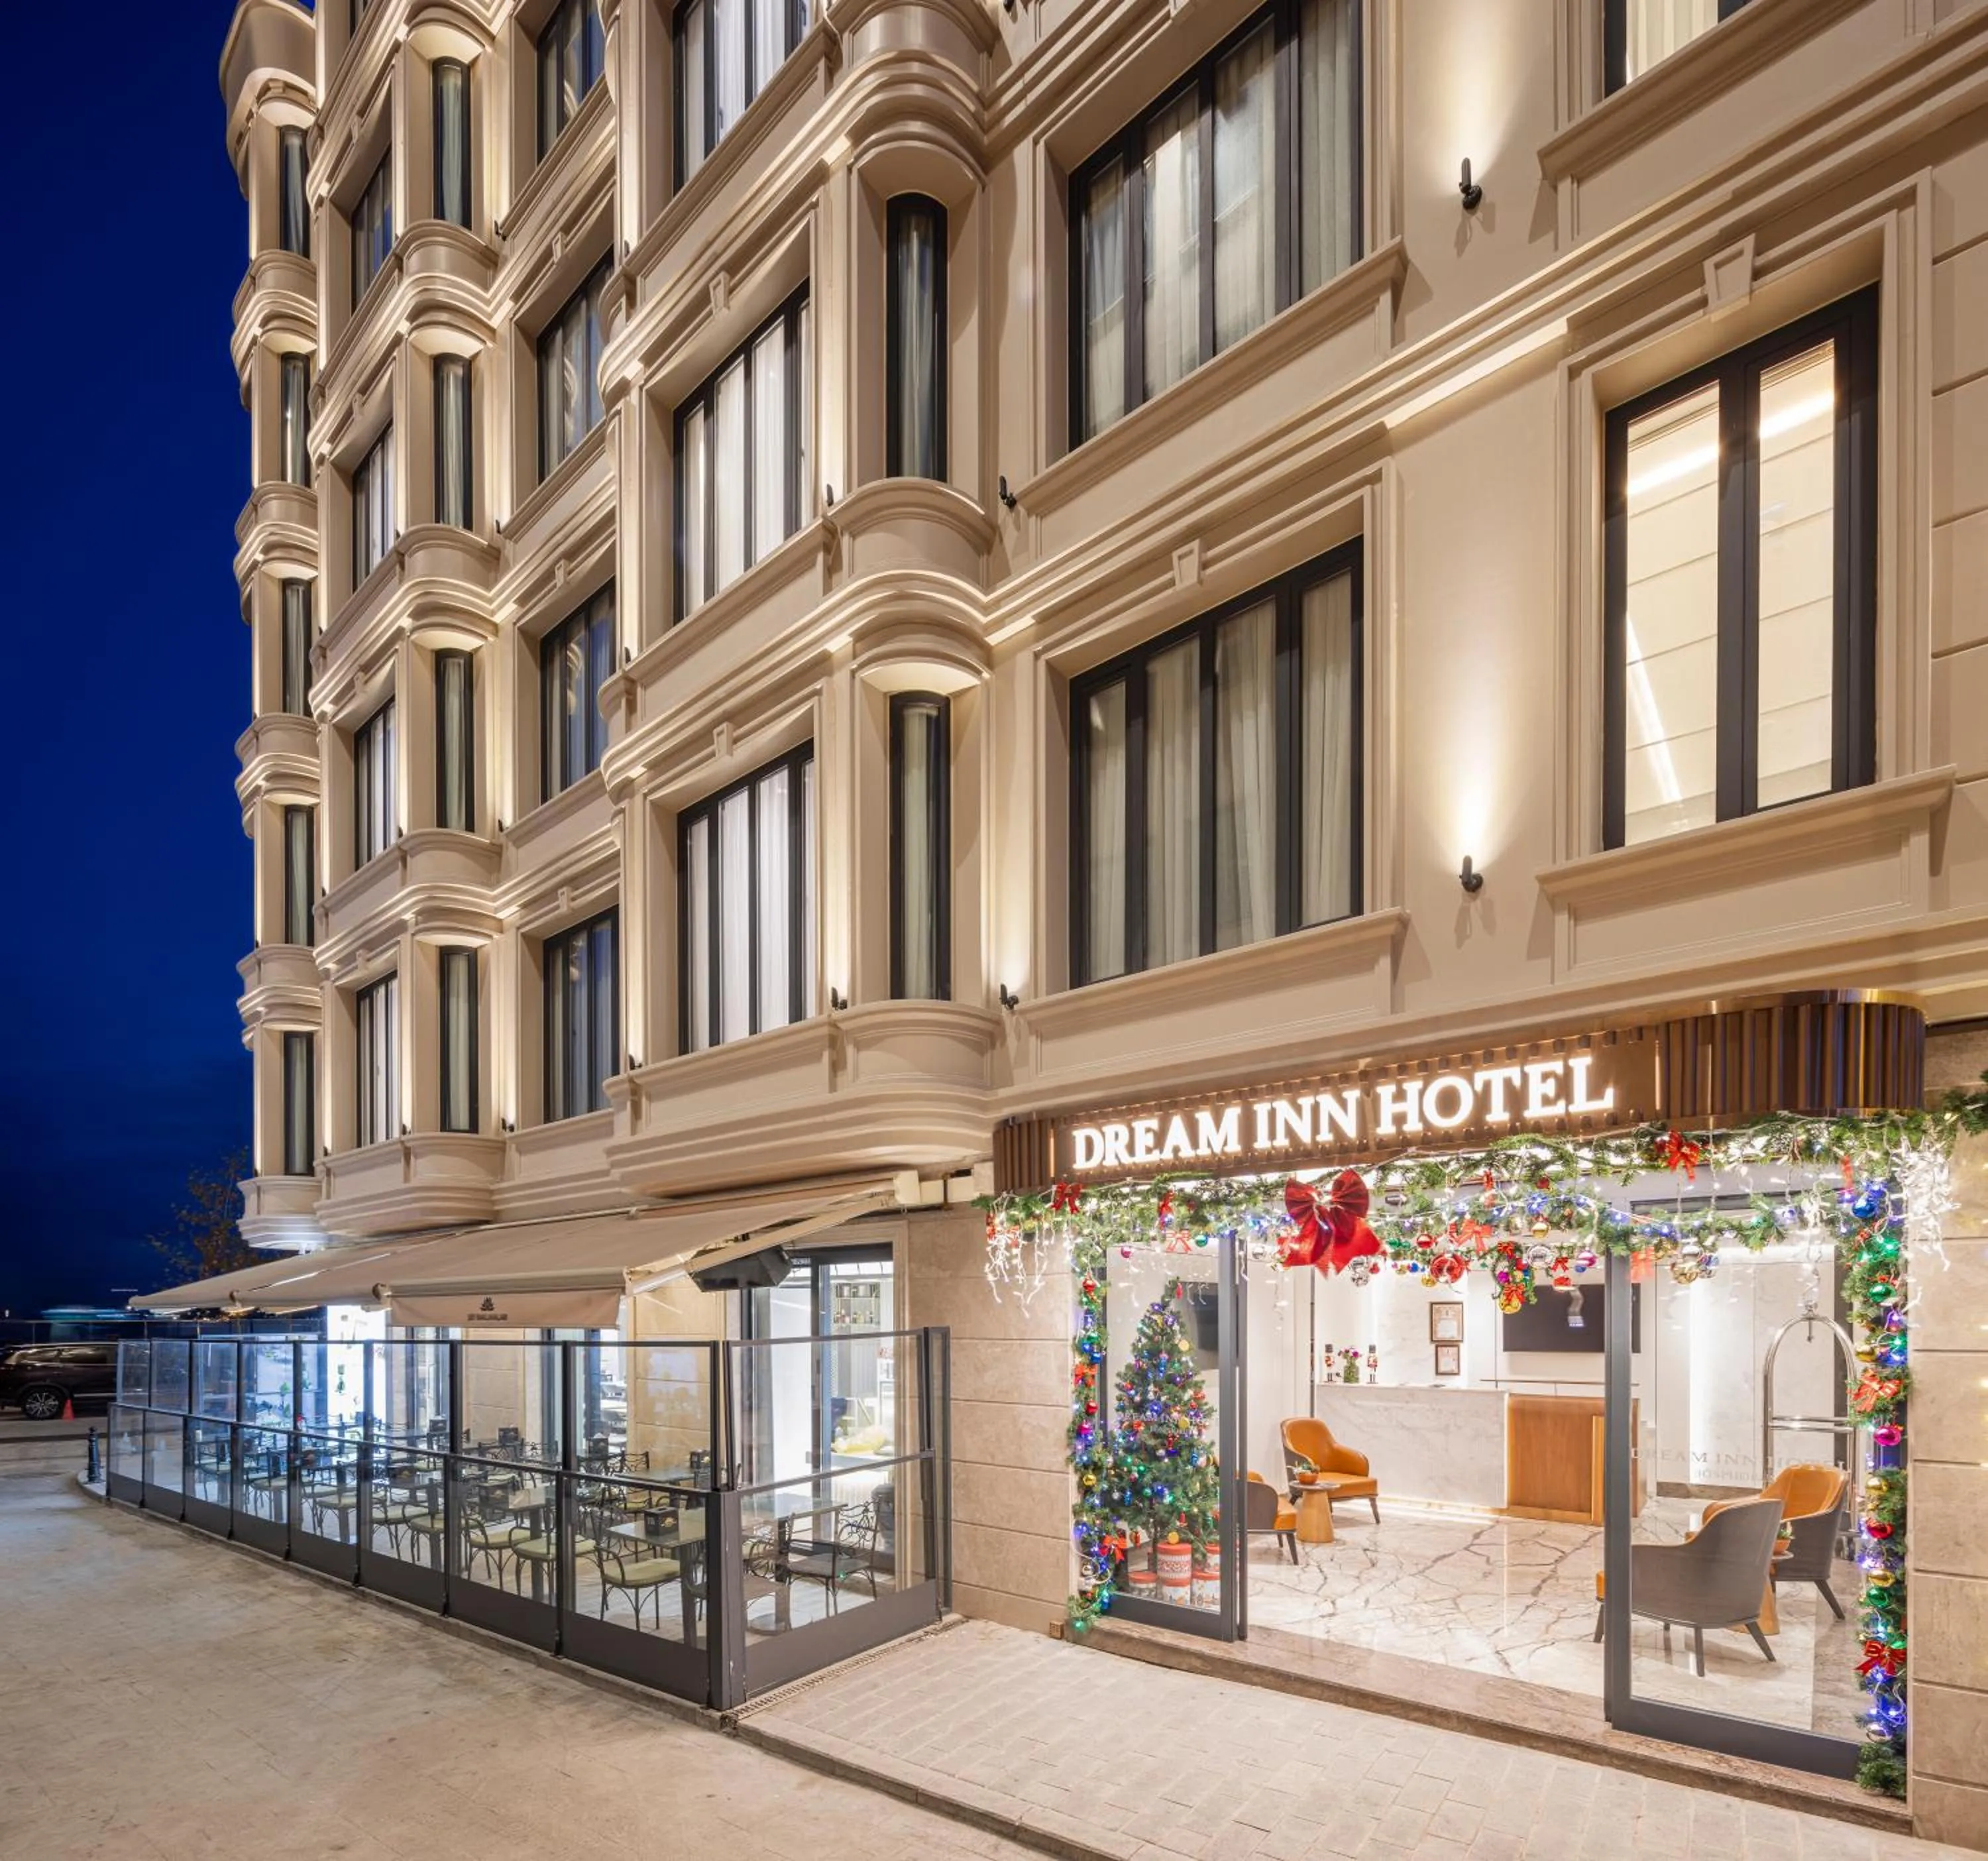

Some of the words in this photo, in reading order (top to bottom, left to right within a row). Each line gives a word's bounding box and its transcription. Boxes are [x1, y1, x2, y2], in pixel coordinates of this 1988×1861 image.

[1072, 1107, 1242, 1170] DREAM
[1253, 1089, 1360, 1149] INN
[1375, 1057, 1614, 1135] HOTEL
